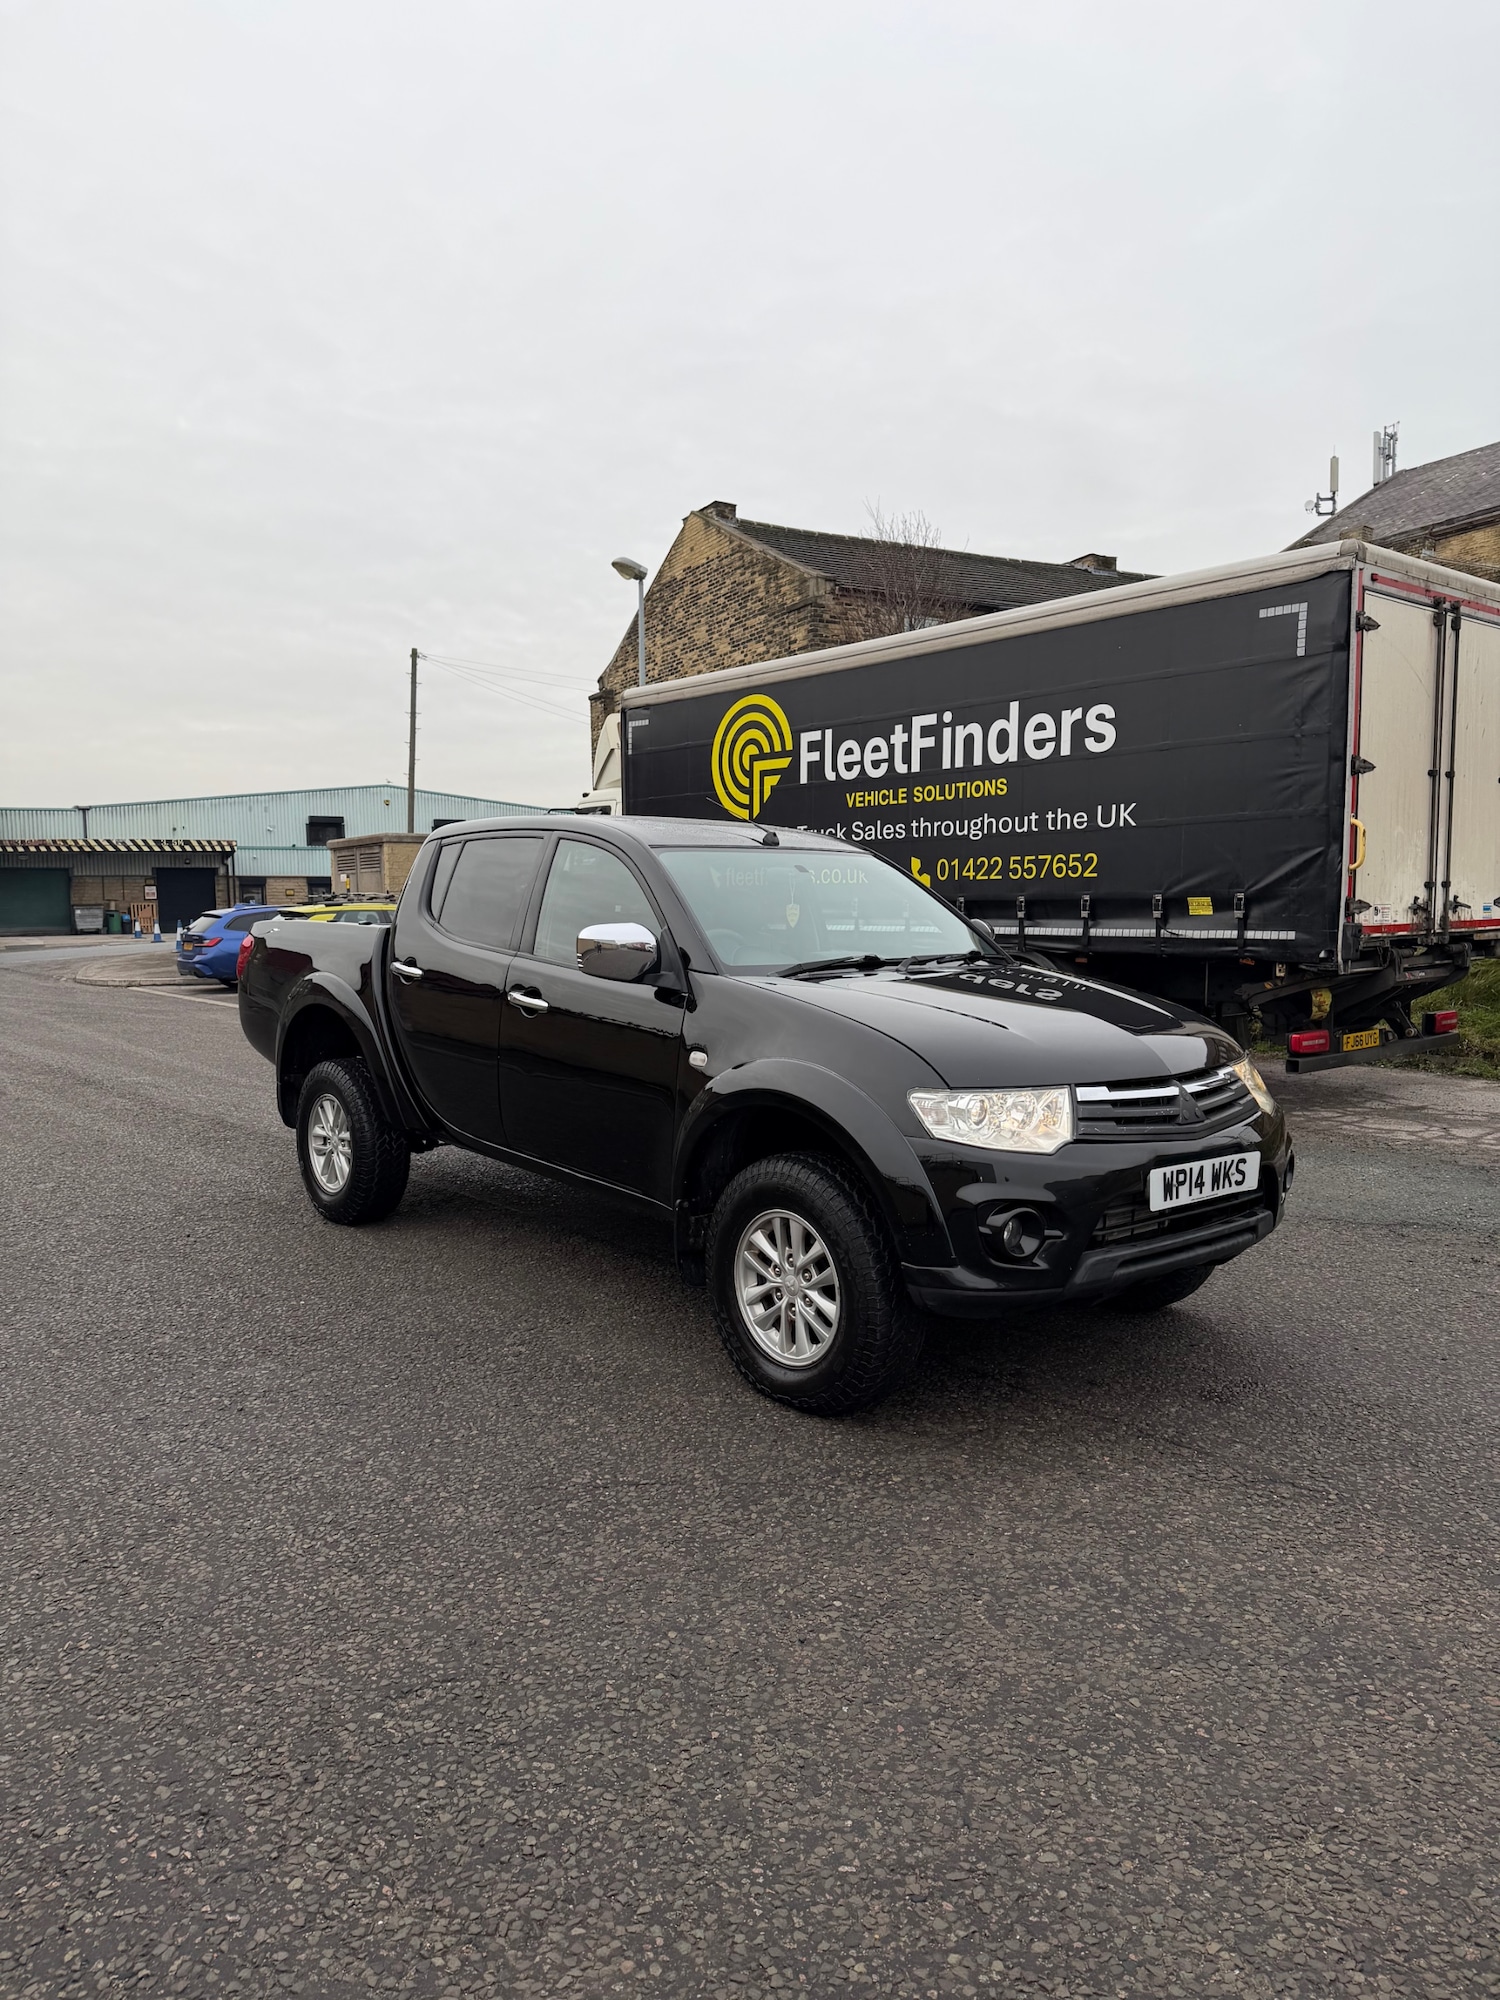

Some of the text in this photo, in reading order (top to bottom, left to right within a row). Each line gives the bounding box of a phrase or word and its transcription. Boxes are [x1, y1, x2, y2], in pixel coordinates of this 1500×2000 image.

[799, 701, 1118, 785] FleetFinders
[846, 778, 1008, 808] VEHICLE SOLUTIONS
[851, 819, 906, 841] Sales
[911, 811, 1040, 840] throughout
[1046, 807, 1088, 831] the
[1097, 802, 1138, 829] UK
[936, 852, 1098, 881] 01422 557652
[1163, 1157, 1248, 1202] WP14 WKS
